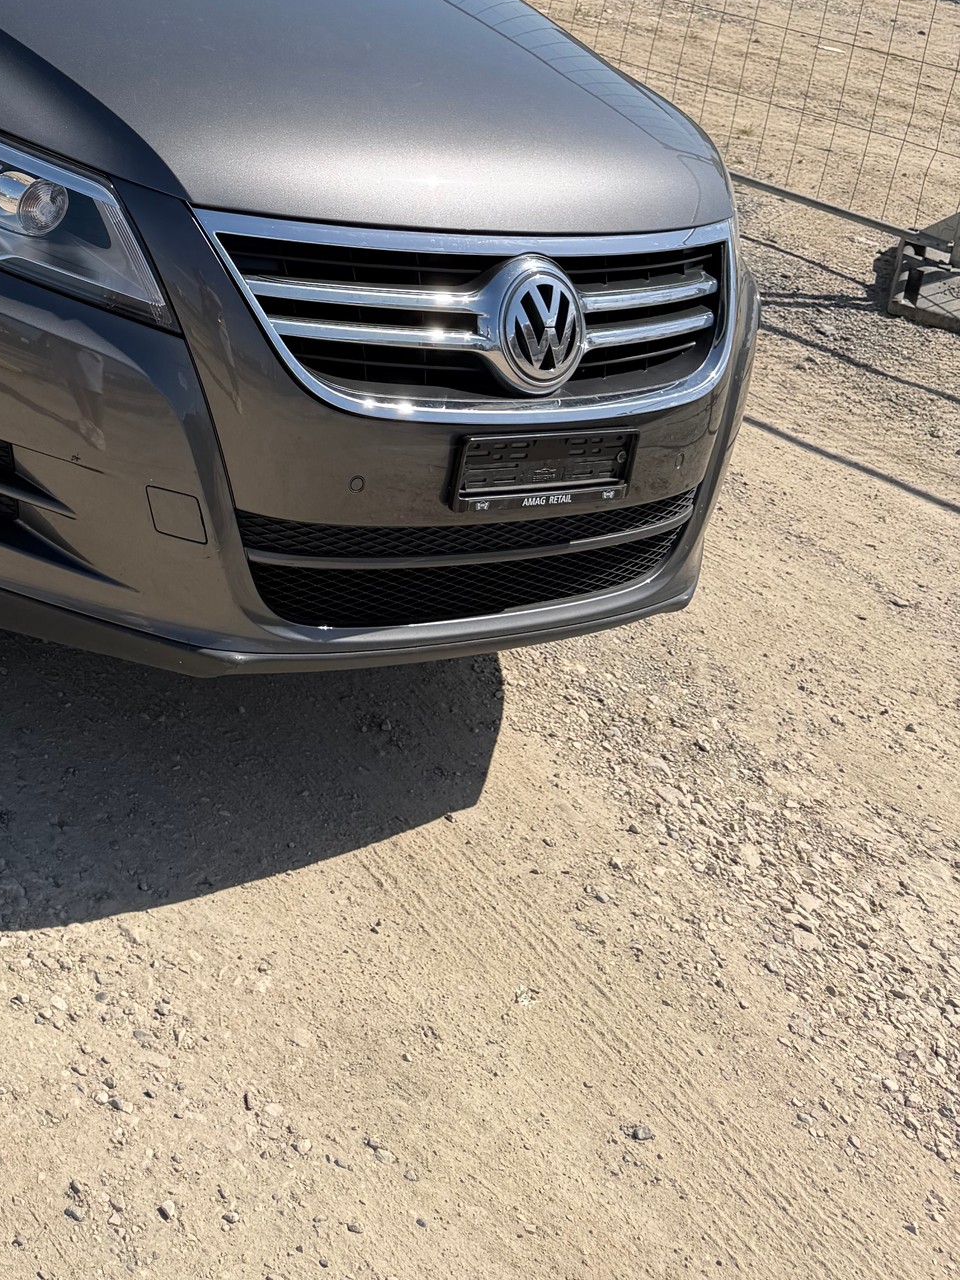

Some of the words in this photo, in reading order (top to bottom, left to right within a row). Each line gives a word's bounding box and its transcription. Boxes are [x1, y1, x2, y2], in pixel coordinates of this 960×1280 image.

[506, 276, 577, 376] VW
[521, 495, 546, 507] AMAG
[548, 494, 572, 504] RETAIL
